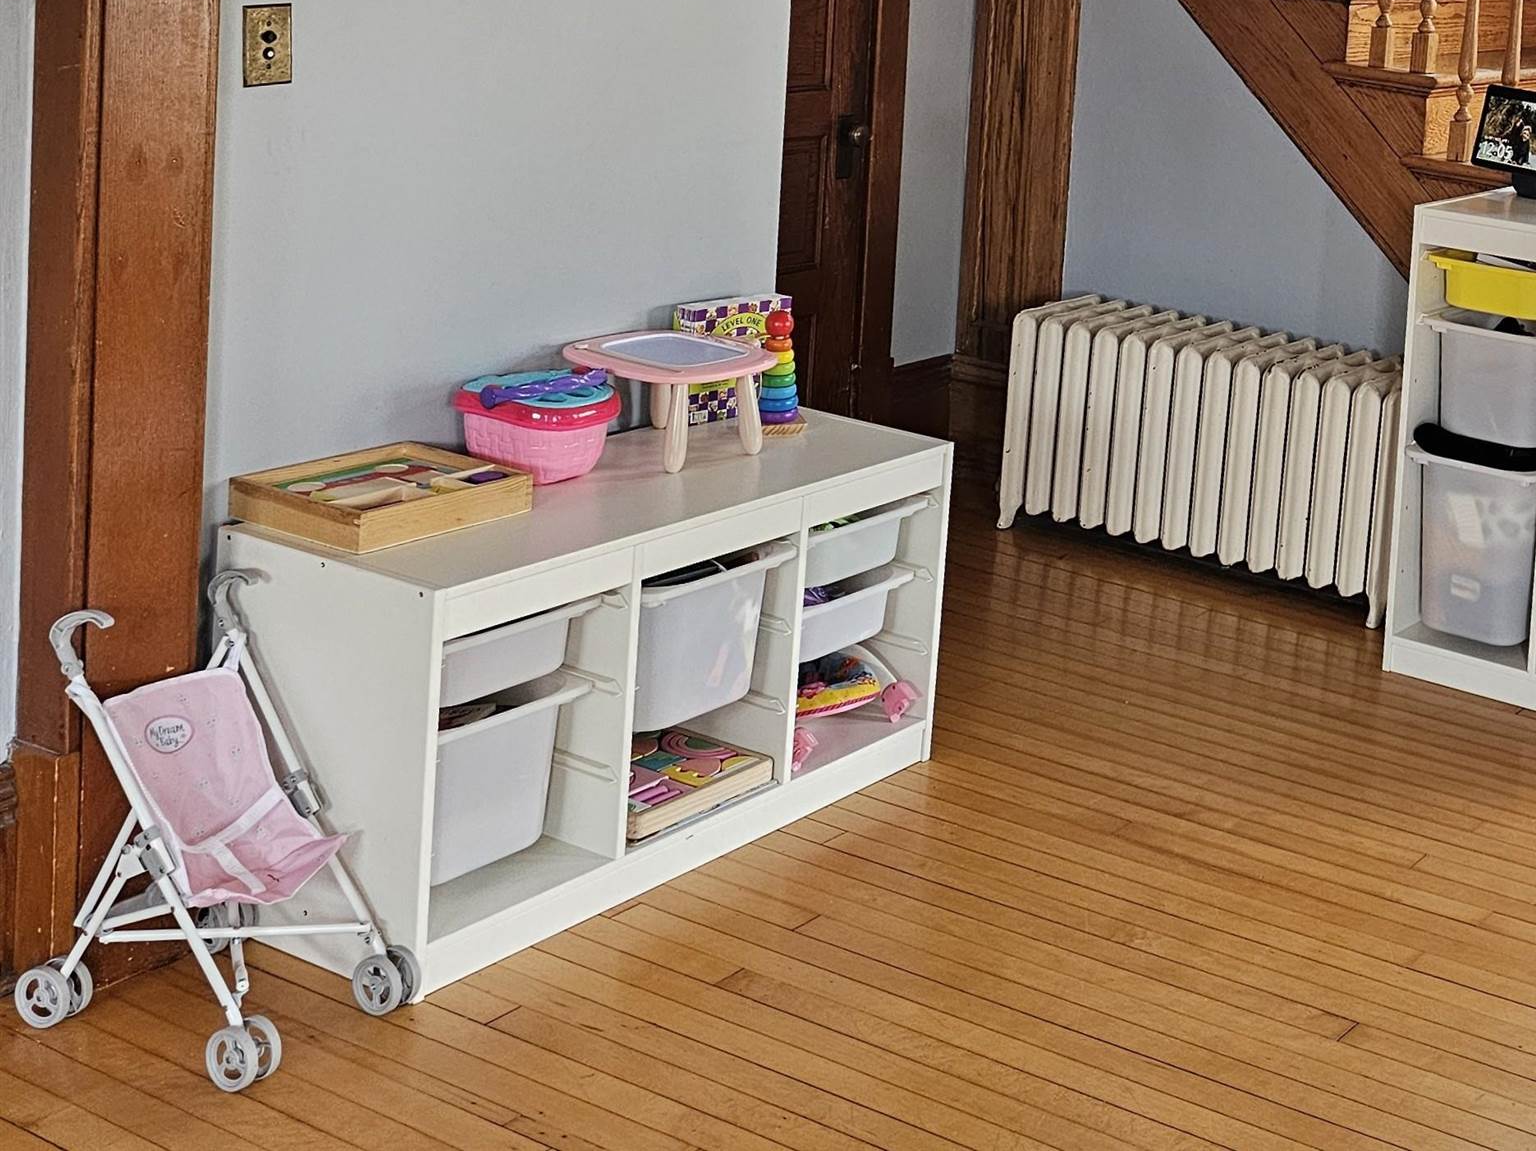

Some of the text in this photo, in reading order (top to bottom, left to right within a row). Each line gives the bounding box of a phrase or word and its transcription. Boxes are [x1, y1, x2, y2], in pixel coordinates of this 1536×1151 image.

[1479, 141, 1514, 159] 12:05
[720, 316, 762, 332] LEVEL ONE
